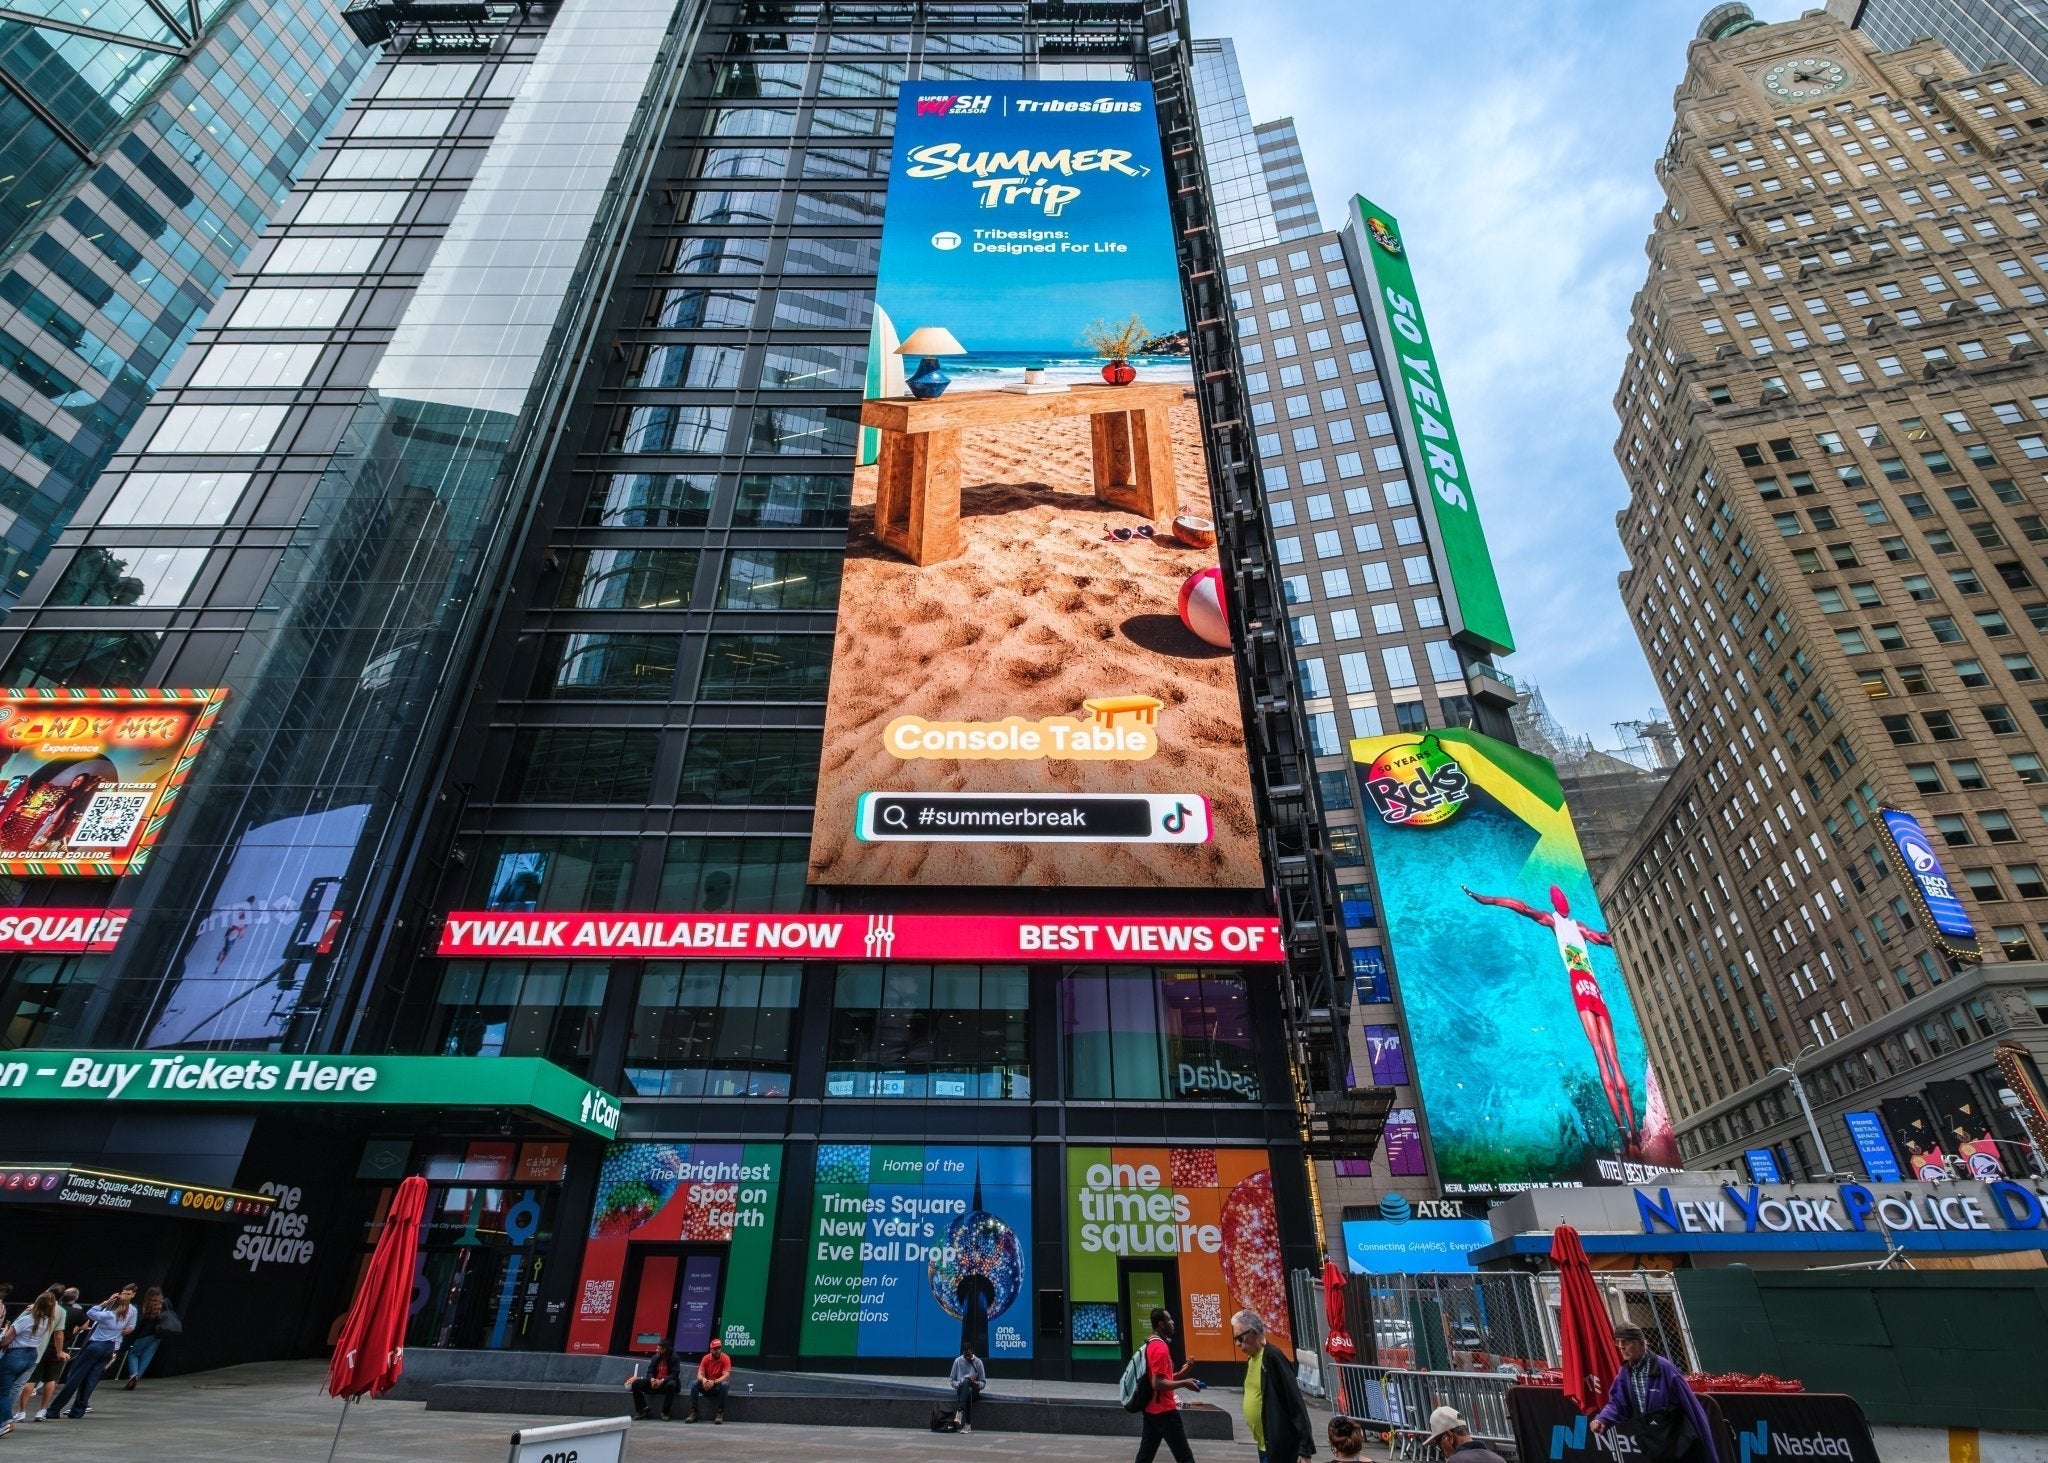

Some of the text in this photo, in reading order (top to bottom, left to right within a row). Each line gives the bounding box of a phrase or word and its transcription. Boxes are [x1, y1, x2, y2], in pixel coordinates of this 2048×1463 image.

[1016, 97, 1141, 113] Tribesigns
[972, 178, 1081, 216] Trip
[974, 229, 1068, 241] Tribesigns:
[973, 243, 1127, 255] Designed For Life
[1386, 286, 1467, 512] 50 YEARS
[8, 717, 181, 739] CANDY NYC
[894, 724, 1146, 751] Console Table
[41, 744, 99, 753] Experience
[1378, 751, 1430, 774] 50 YEARS
[918, 808, 1087, 827] #summerbreak
[18, 851, 65, 860] CULTURE
[66, 851, 110, 860] COLLIDE
[1917, 874, 1954, 899] TACO BELL
[572, 922, 748, 948] AVAILABLE
[755, 923, 843, 949] NOW
[1019, 924, 1099, 951] BEST
[1105, 925, 1214, 952] VIEWS
[1221, 926, 1265, 952] OF
[61, 1057, 142, 1099] Buy
[146, 1055, 280, 1091] Tickets
[284, 1060, 377, 1092] Here
[650, 1160, 770, 1186] The Brightest
[883, 1159, 964, 1171] Home of the
[1623, 1162, 1646, 1182] BEST
[67, 1174, 96, 1189] Times
[1086, 1163, 1161, 1191] one
[59, 1189, 132, 1208] Subway Station
[688, 1185, 767, 1208] Spot on
[822, 1193, 966, 1219] Times Square
[1079, 1187, 1190, 1222] times
[708, 1208, 764, 1227] Earth
[1416, 1200, 1463, 1218] AT&T
[1634, 1187, 1726, 1234] NEW
[1722, 1185, 1844, 1233] YORK
[1840, 1184, 1990, 1232] POLICE
[819, 1217, 935, 1238] New Year's
[1081, 1223, 1222, 1255] square
[1358, 1242, 1406, 1253] Connecting
[232, 1235, 315, 1271] square
[817, 1242, 957, 1268] Eve Ball Drop
[815, 1274, 898, 1291] Now open for
[812, 1292, 885, 1307] year-round
[811, 1308, 889, 1322] celebrations
[725, 1331, 750, 1340] times
[995, 1332, 1020, 1341] times
[997, 1326, 1014, 1334] one
[724, 1338, 756, 1349] square
[995, 1340, 1026, 1350] square
[1771, 1431, 1854, 1463] Nasdaq
